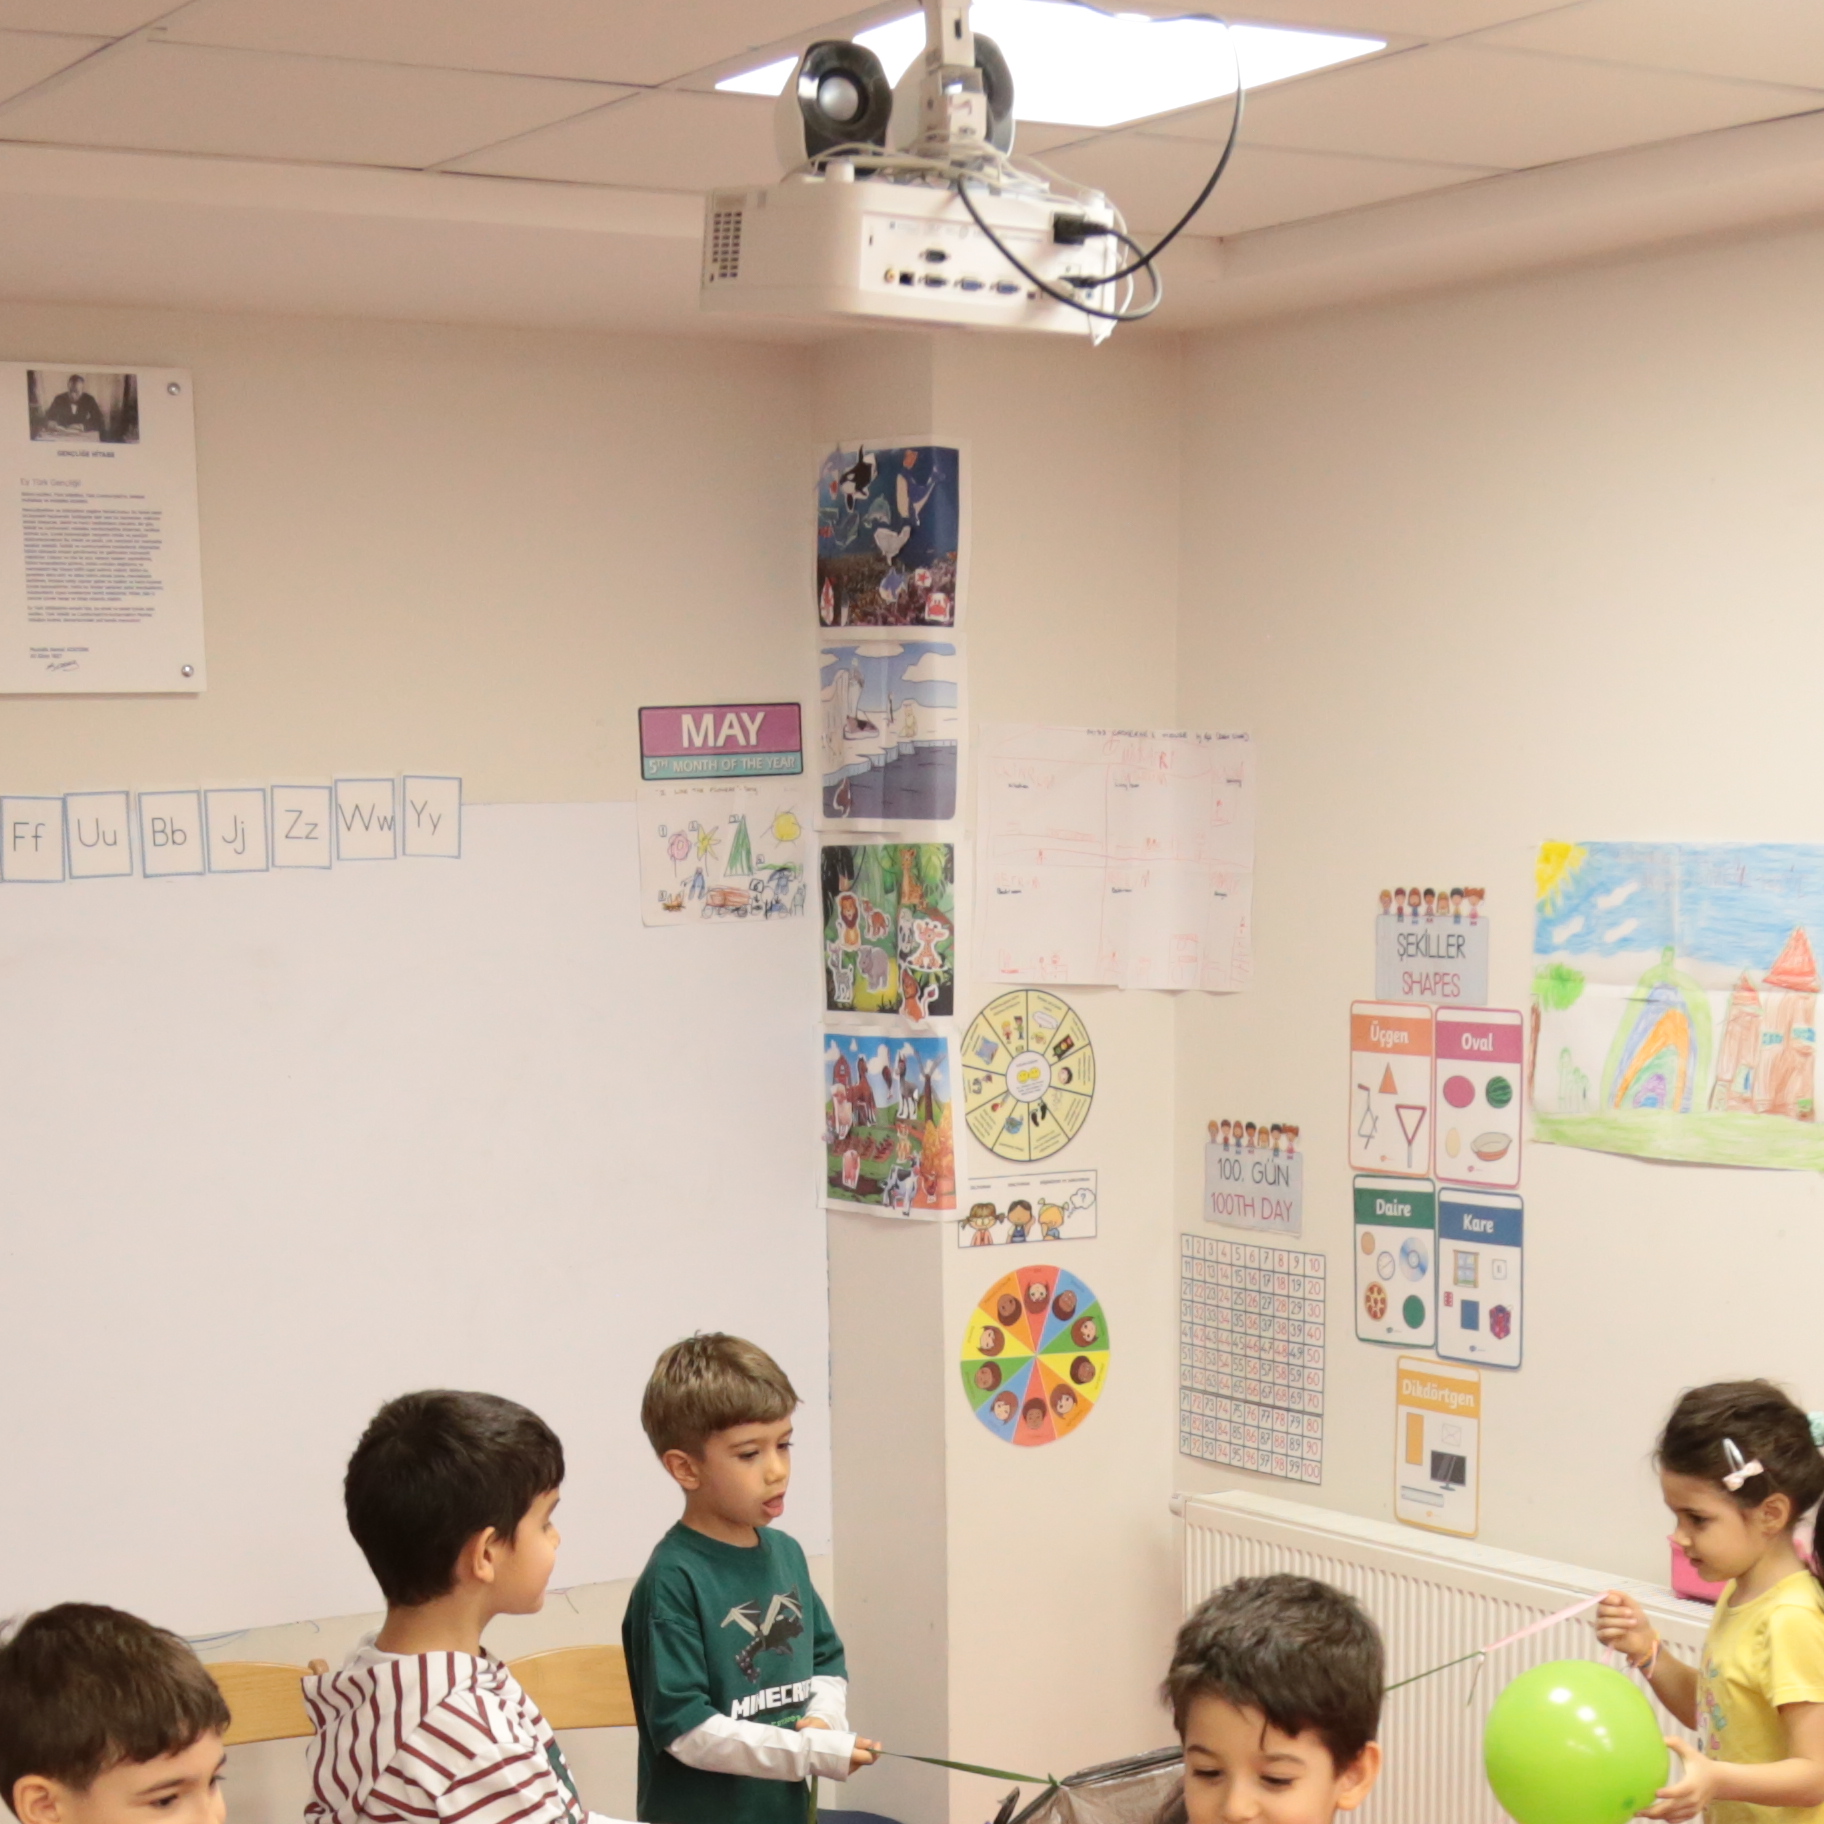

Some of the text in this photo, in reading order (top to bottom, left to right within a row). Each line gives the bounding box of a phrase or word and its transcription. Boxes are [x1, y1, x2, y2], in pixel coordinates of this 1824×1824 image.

[681, 712, 765, 748] MAY
[673, 758, 717, 772] MONTH
[722, 758, 736, 770] OF
[742, 757, 763, 769] THE
[768, 756, 795, 769] YEAR
[153, 817, 187, 848] Bb
[285, 810, 318, 842] Zz
[338, 804, 393, 837] Ww
[410, 800, 442, 835] Yy
[12, 820, 45, 853] Ff
[78, 818, 117, 849] Uu
[222, 813, 246, 856] Jj
[1397, 929, 1465, 961] ŞEKİLLER
[1403, 971, 1460, 997] SHAPES
[1370, 1021, 1409, 1048] Üçgen
[1462, 1033, 1493, 1051] Oval
[1252, 1158, 1289, 1187] GÜN
[1211, 1192, 1293, 1222] 100TH DAY
[1376, 1198, 1412, 1218] Daire
[1463, 1213, 1494, 1233] Kare
[1185, 1260, 1321, 1295] 11 12 13 14 15 16 17 18 19 20
[1402, 1378, 1475, 1409] Dikdörtgen
[1182, 1436, 1320, 1480] 91 92 93 94 95 96 97 98 99 100
